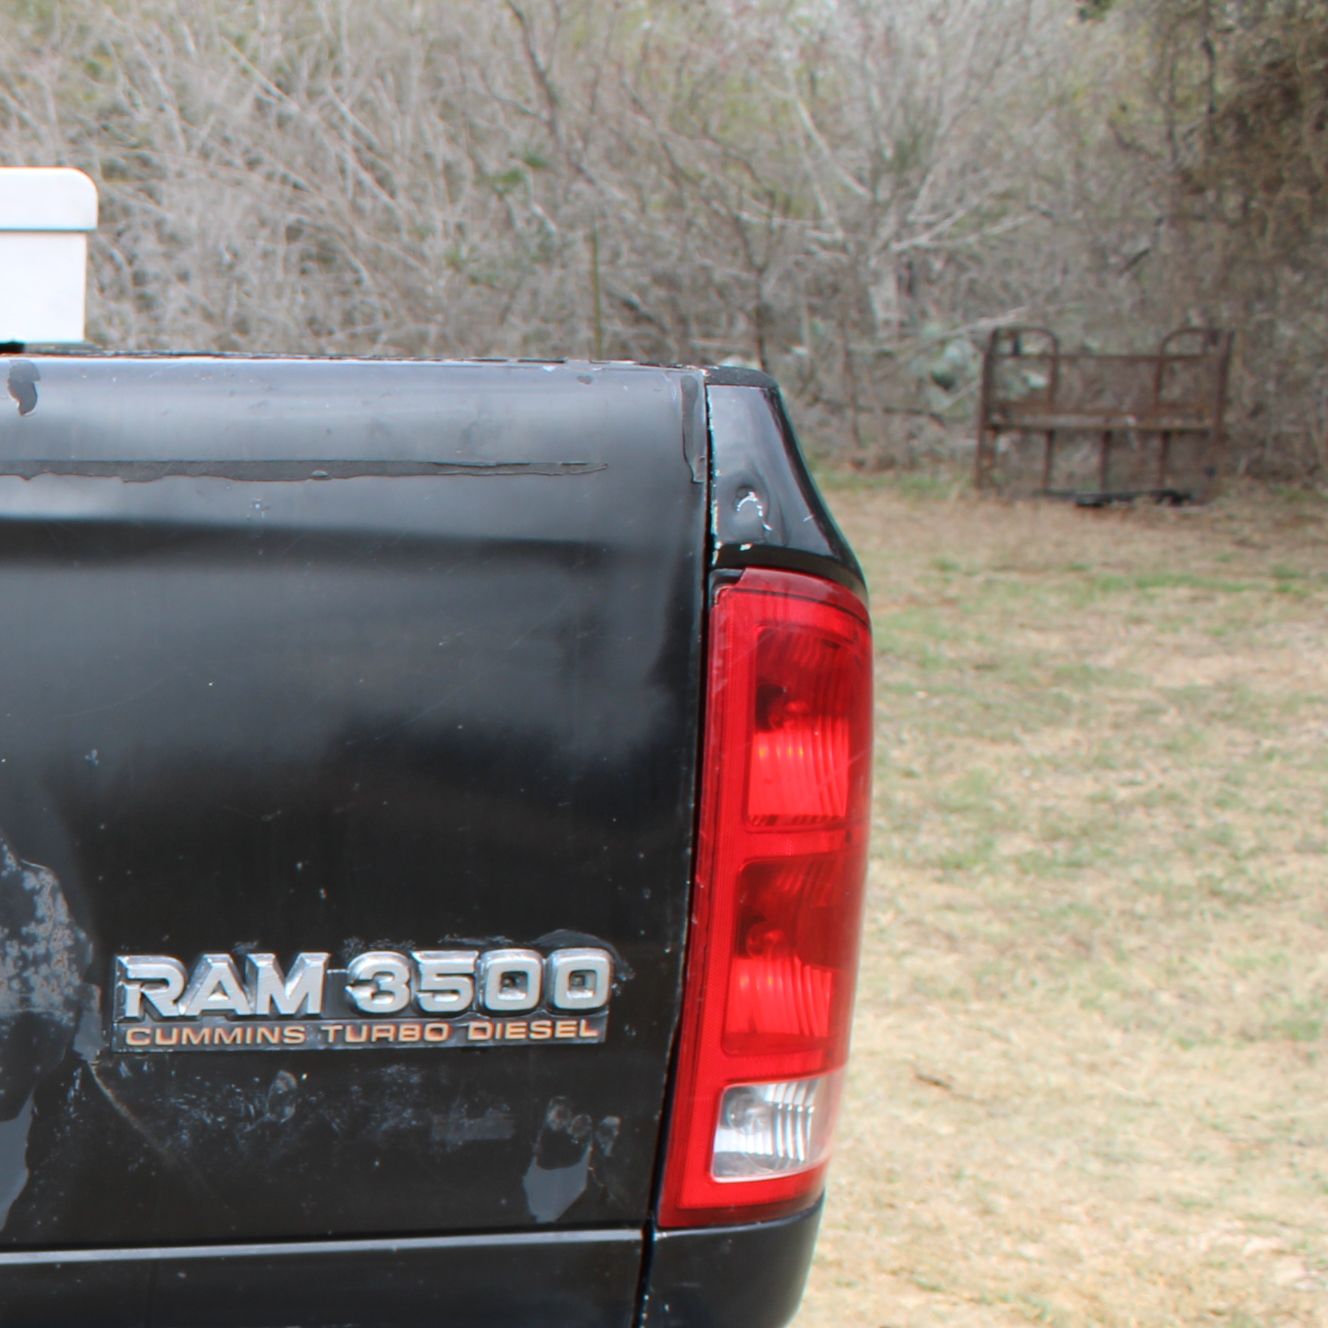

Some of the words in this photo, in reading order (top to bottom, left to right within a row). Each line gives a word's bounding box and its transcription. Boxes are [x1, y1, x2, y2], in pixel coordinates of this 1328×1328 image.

[115, 953, 330, 1018] RAM
[345, 948, 613, 1015] 3500
[125, 1025, 306, 1047] CUMMINS
[320, 1022, 450, 1043] TURBO
[467, 1019, 599, 1041] DIESEL
